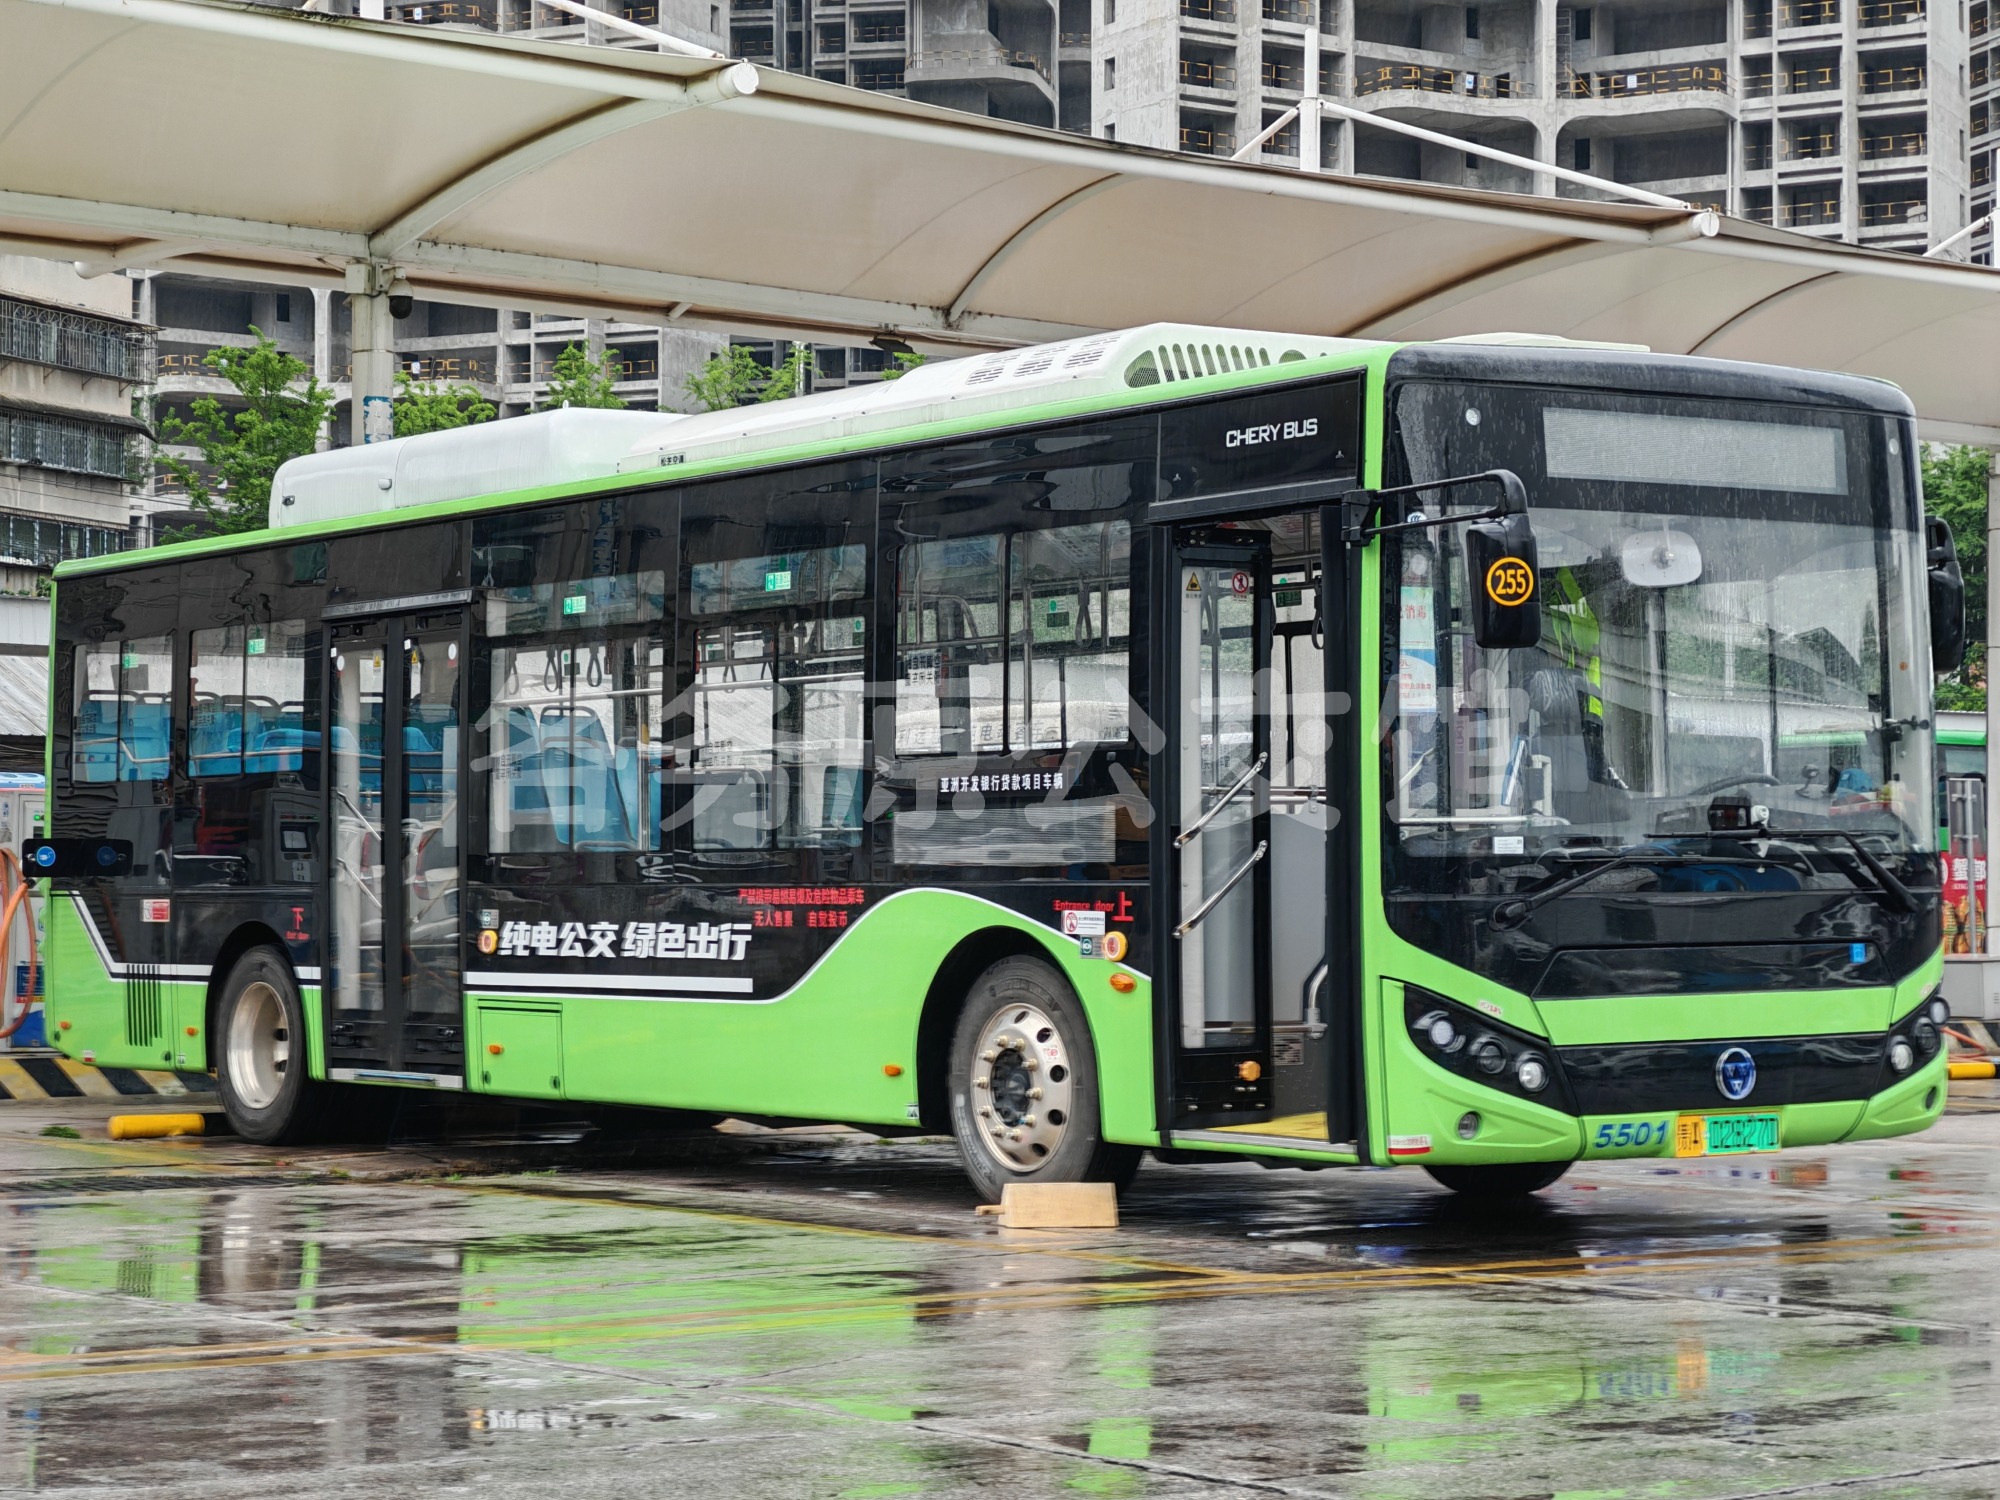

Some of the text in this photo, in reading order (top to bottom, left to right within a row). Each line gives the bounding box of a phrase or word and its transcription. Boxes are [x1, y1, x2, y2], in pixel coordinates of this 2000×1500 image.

[1226, 418, 1318, 447] CHERY BUS
[1495, 569, 1526, 595] 255
[940, 772, 1064, 793] 亚洲开发银行贷款项目车辆
[292, 908, 305, 930] 下
[1053, 900, 1115, 912] Entrance door
[1112, 891, 1134, 922] 上
[754, 911, 848, 928] 无人售票 自觉投币
[498, 920, 752, 961] 纯电公交 绿色出行
[1594, 1120, 1669, 1149] 5501
